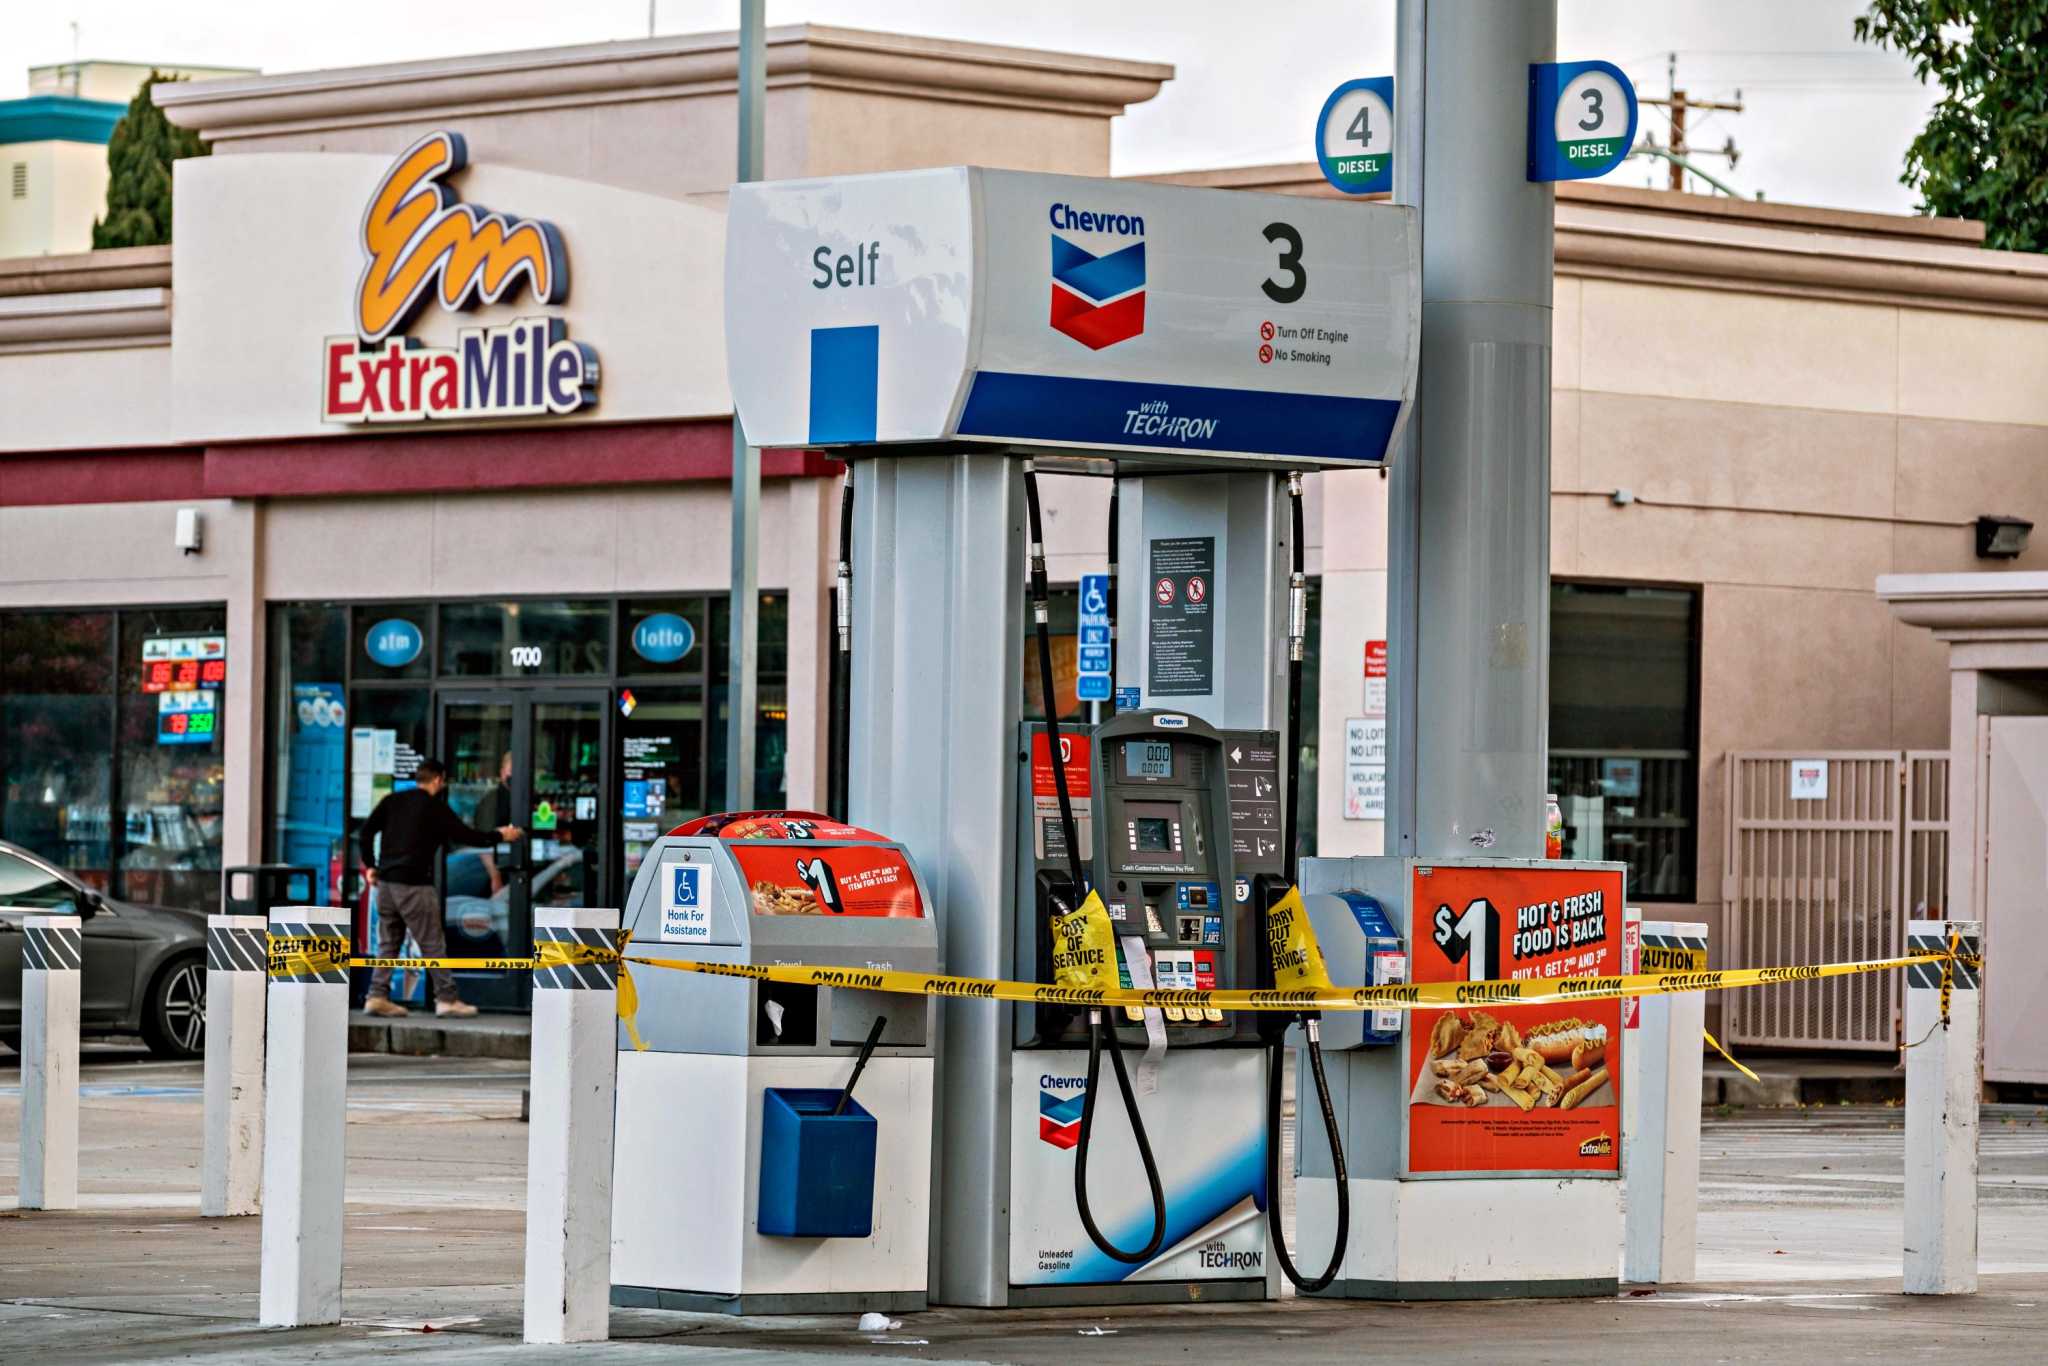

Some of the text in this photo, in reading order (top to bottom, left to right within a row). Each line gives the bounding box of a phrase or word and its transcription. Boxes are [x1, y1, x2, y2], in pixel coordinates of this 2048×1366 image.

[1578, 88, 1604, 131] 3
[1346, 107, 1372, 148] 4
[1569, 144, 1613, 158] DIESEL
[1338, 160, 1379, 174] DIESEL
[1050, 203, 1145, 236] Chevron
[812, 241, 880, 289] Self
[1261, 222, 1307, 304] 3
[1277, 326, 1349, 344] Turn Off Engine
[1274, 350, 1331, 366] No Smoking
[327, 322, 581, 415] ExtraMile
[1140, 401, 1168, 414] with
[1123, 410, 1217, 442] TECHRON
[379, 632, 410, 651] atm
[640, 627, 684, 648] lotto
[511, 647, 542, 667] 1700
[1351, 728, 1363, 740] NO
[1351, 745, 1363, 757] NO
[797, 858, 834, 904] $1
[840, 875, 853, 885] BUY
[881, 867, 892, 877] AND
[848, 882, 862, 891] ITEM
[863, 880, 875, 889] FOR
[883, 875, 897, 885] EACH
[1238, 886, 1244, 897] 3
[668, 910, 704, 922] Honk For
[1268, 907, 1294, 929] ORRY
[1518, 891, 1601, 929] HOT & FRESH
[664, 923, 707, 937] Assistance
[1513, 915, 1604, 955] FOOD IS BACK
[272, 939, 342, 953] CAUTION
[1067, 936, 1083, 951] OF
[1273, 940, 1287, 955] OF
[1434, 900, 1488, 981] $1
[1054, 949, 1104, 969] SERVICE
[1272, 948, 1306, 971] ERVICE
[1545, 960, 1561, 977] GET
[1578, 952, 1595, 969] AND
[1641, 951, 1694, 970] AUTION
[1038, 1250, 1073, 1260] Unleaded
[1206, 1241, 1225, 1251] with
[1038, 1261, 1071, 1270] Gasoline
[1199, 1250, 1262, 1270] TECHRON
